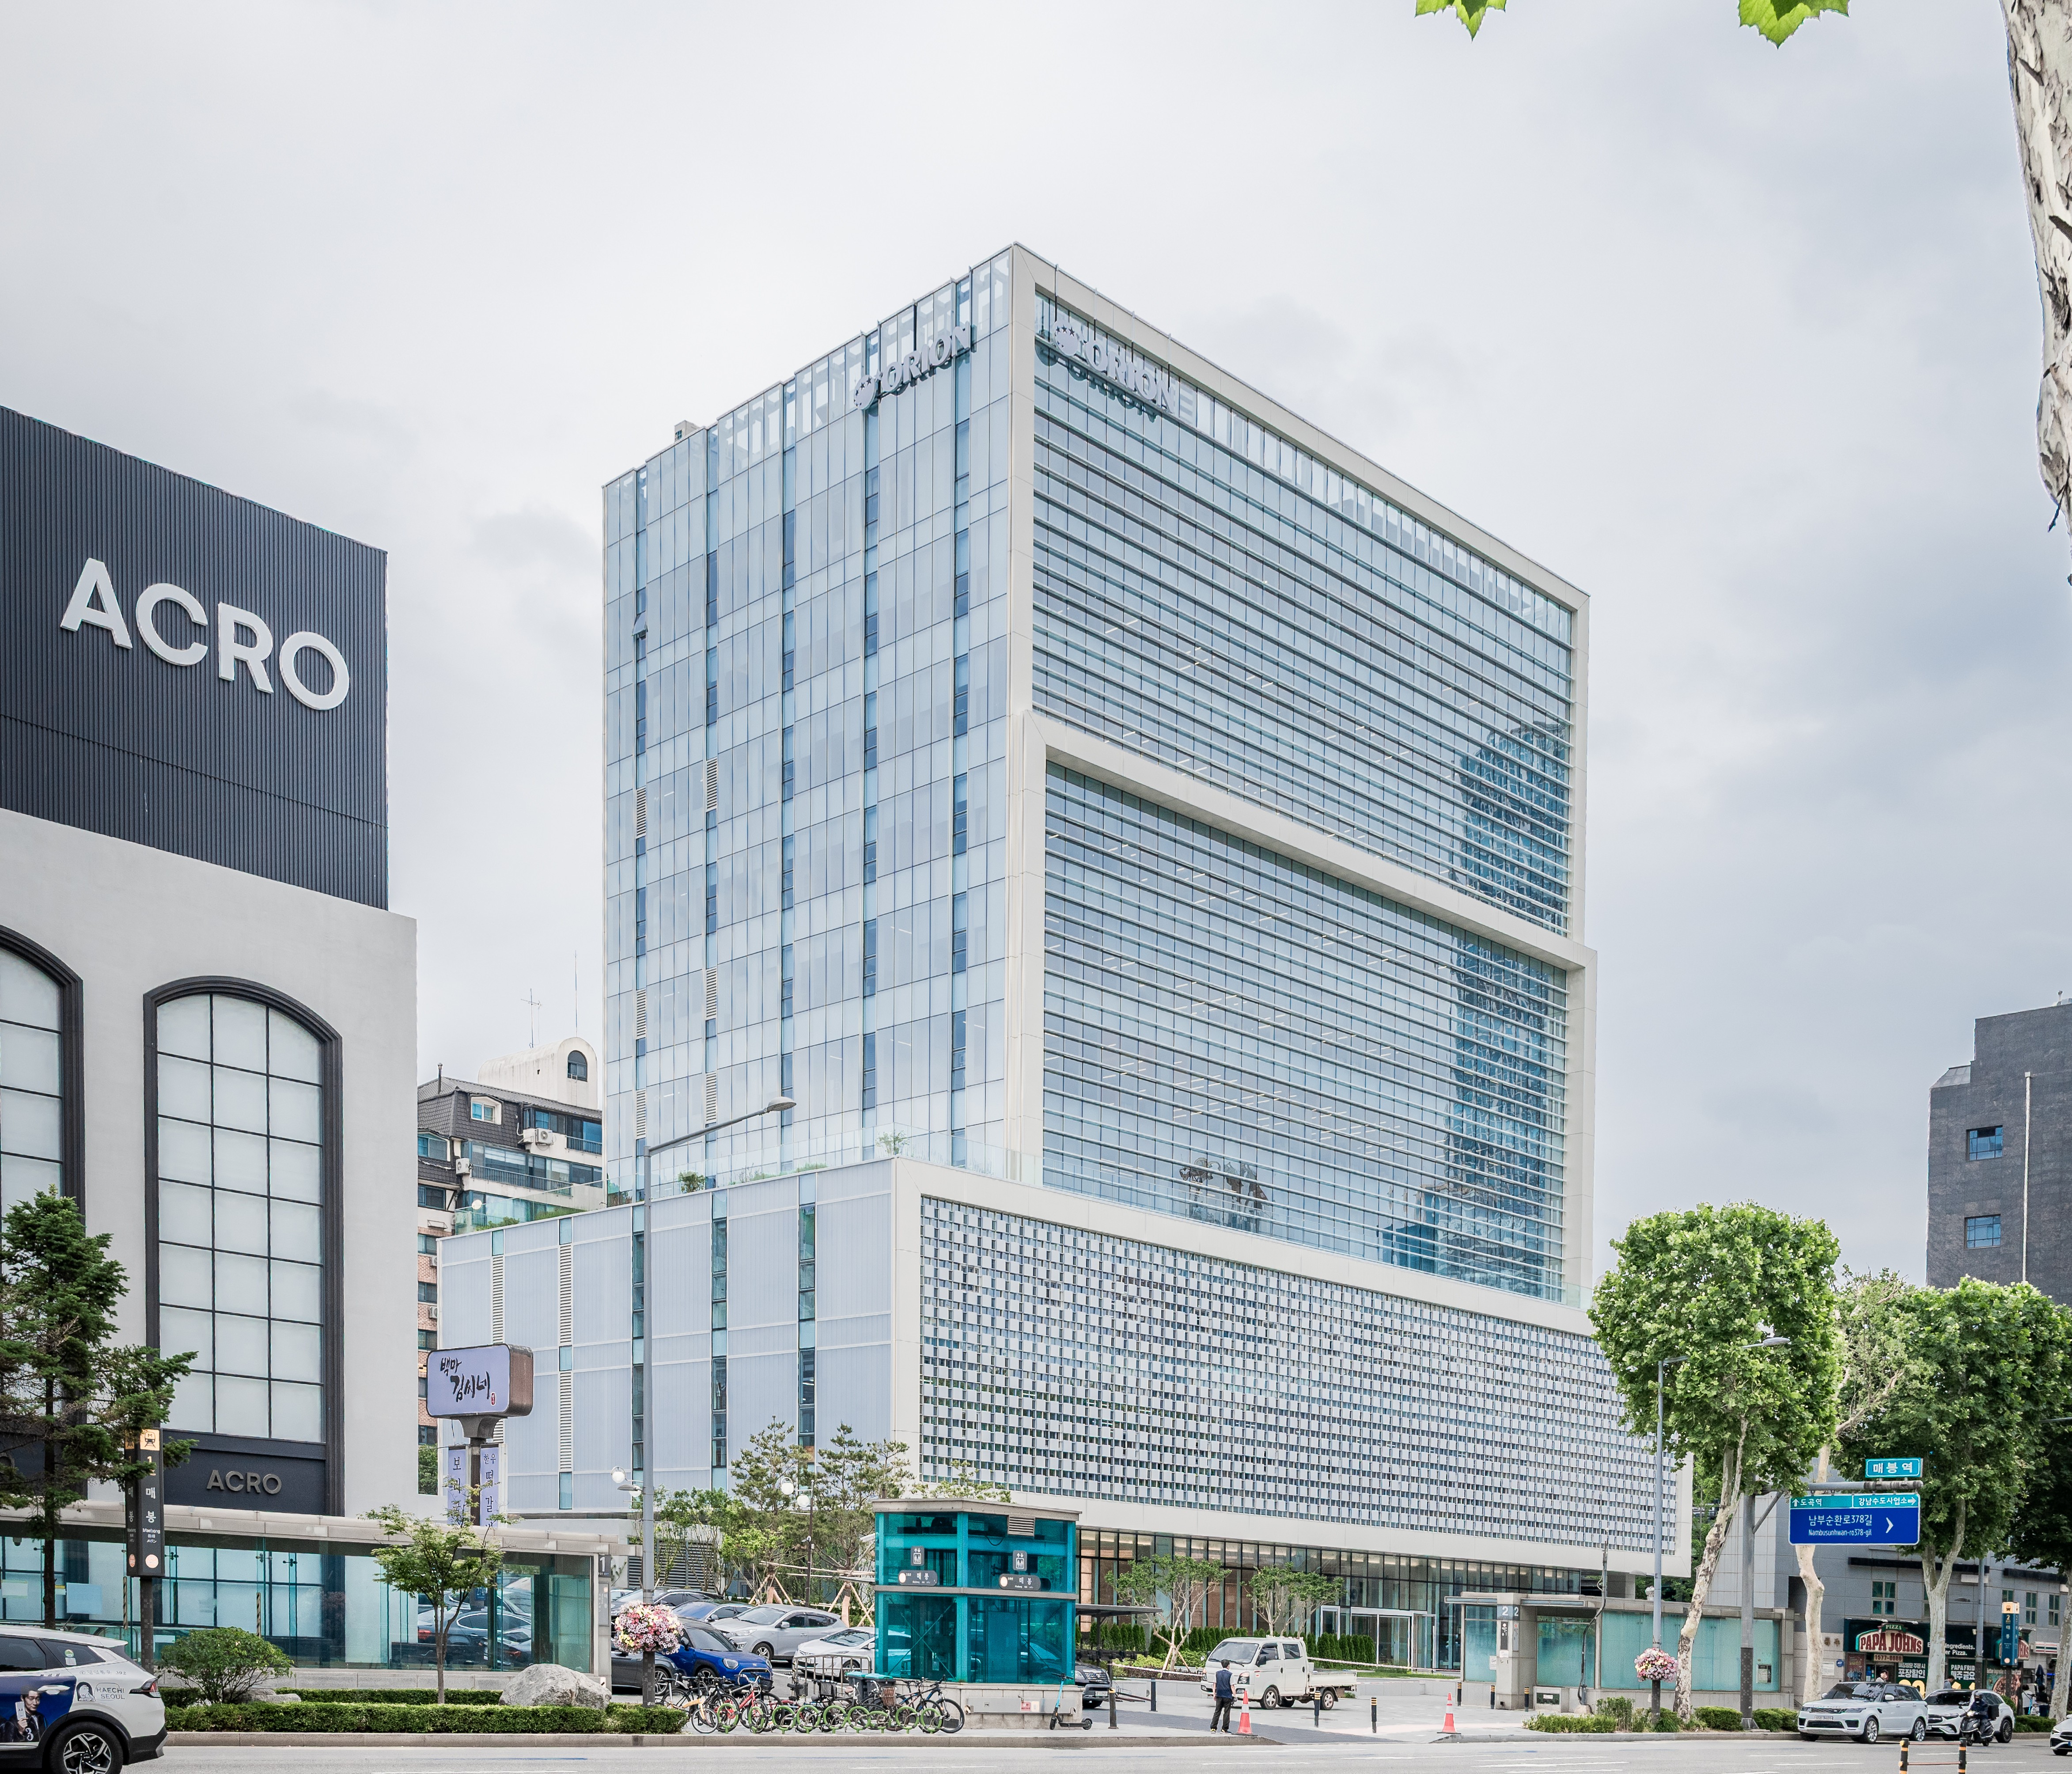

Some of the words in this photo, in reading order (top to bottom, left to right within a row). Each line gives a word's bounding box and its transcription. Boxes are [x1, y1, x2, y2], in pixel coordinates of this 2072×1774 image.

[881, 322, 970, 392] ORION
[1084, 340, 1177, 414] ORION
[60, 557, 350, 711] ACRO
[450, 1371, 490, 1403] 김씨네
[1873, 1462, 1913, 1474] 매봉역
[206, 1470, 282, 1494] ACRO
[145, 1487, 156, 1523] 매봉
[1800, 1498, 1822, 1507] 도곡역
[1858, 1497, 1907, 1506] 강남수도사업소
[1808, 1515, 1872, 1526] 남부순환로378길
[1808, 1529, 1872, 1537] Nambusunhwan-ro378-gil
[599, 1556, 606, 1572] 1
[1502, 1606, 1509, 1616] 2
[1514, 1606, 1519, 1617] 2
[1860, 1632, 1887, 1651] PAPA
[1898, 1668, 1926, 1679] 포장할인
[1951, 1671, 1975, 1680] 매주금요
[25, 1727, 34, 1741] 3
